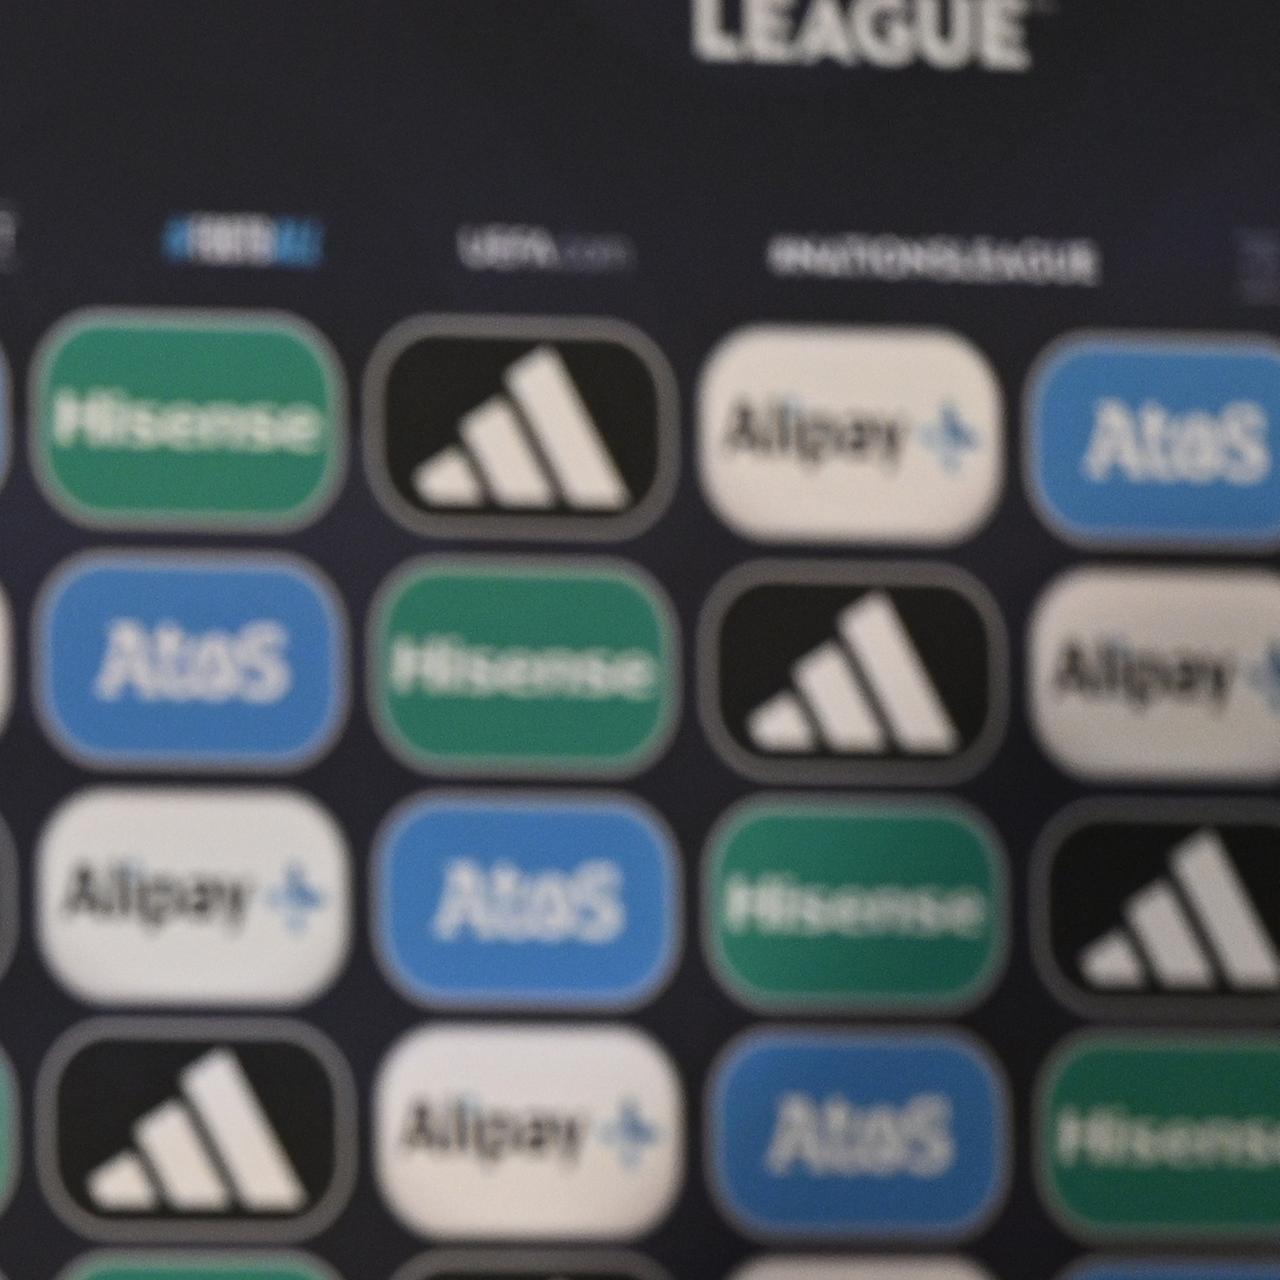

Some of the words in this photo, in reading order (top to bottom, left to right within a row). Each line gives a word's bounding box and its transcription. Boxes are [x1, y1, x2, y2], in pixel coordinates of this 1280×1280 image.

[692, 0, 1029, 70] LEAGUE
[52, 389, 323, 453] Hisense
[389, 635, 656, 699] Hisense
[725, 875, 985, 936] Hisense
[1054, 1107, 1280, 1168] Hisens
